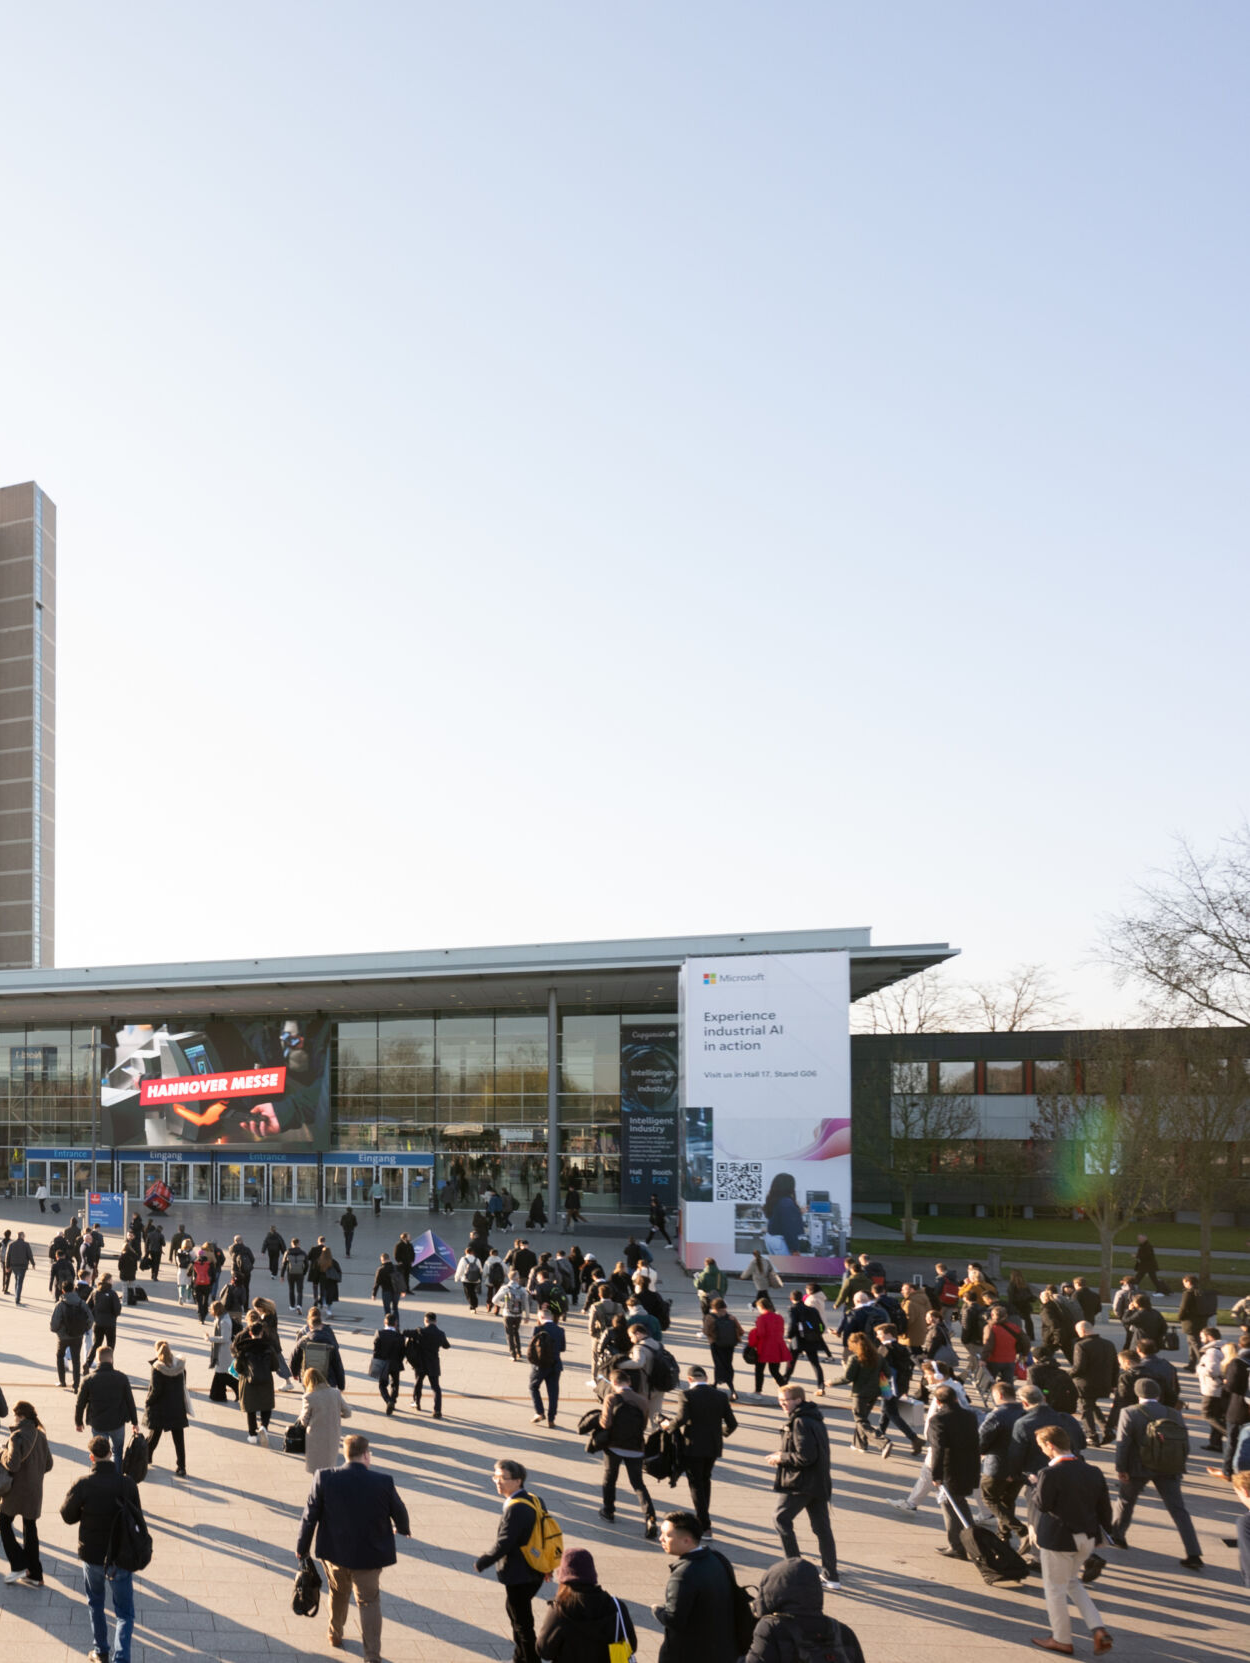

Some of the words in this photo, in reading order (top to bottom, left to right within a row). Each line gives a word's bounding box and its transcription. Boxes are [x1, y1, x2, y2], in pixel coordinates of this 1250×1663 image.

[719, 973, 764, 982] Microsoft
[704, 1011, 776, 1024] Experience
[704, 1025, 766, 1036] industrial
[770, 1025, 783, 1035] AI
[704, 1041, 716, 1051] in
[719, 1041, 761, 1051] action
[147, 1079, 228, 1098] HANNOVER
[231, 1073, 278, 1090] MESSE
[630, 1117, 674, 1125] Intelligent
[630, 1125, 665, 1134] Industry
[54, 1150, 87, 1158] Entrance
[150, 1152, 182, 1161] Eingang
[249, 1153, 286, 1161] Entrance
[359, 1154, 396, 1164] Eingang
[631, 1176, 641, 1184] 15
